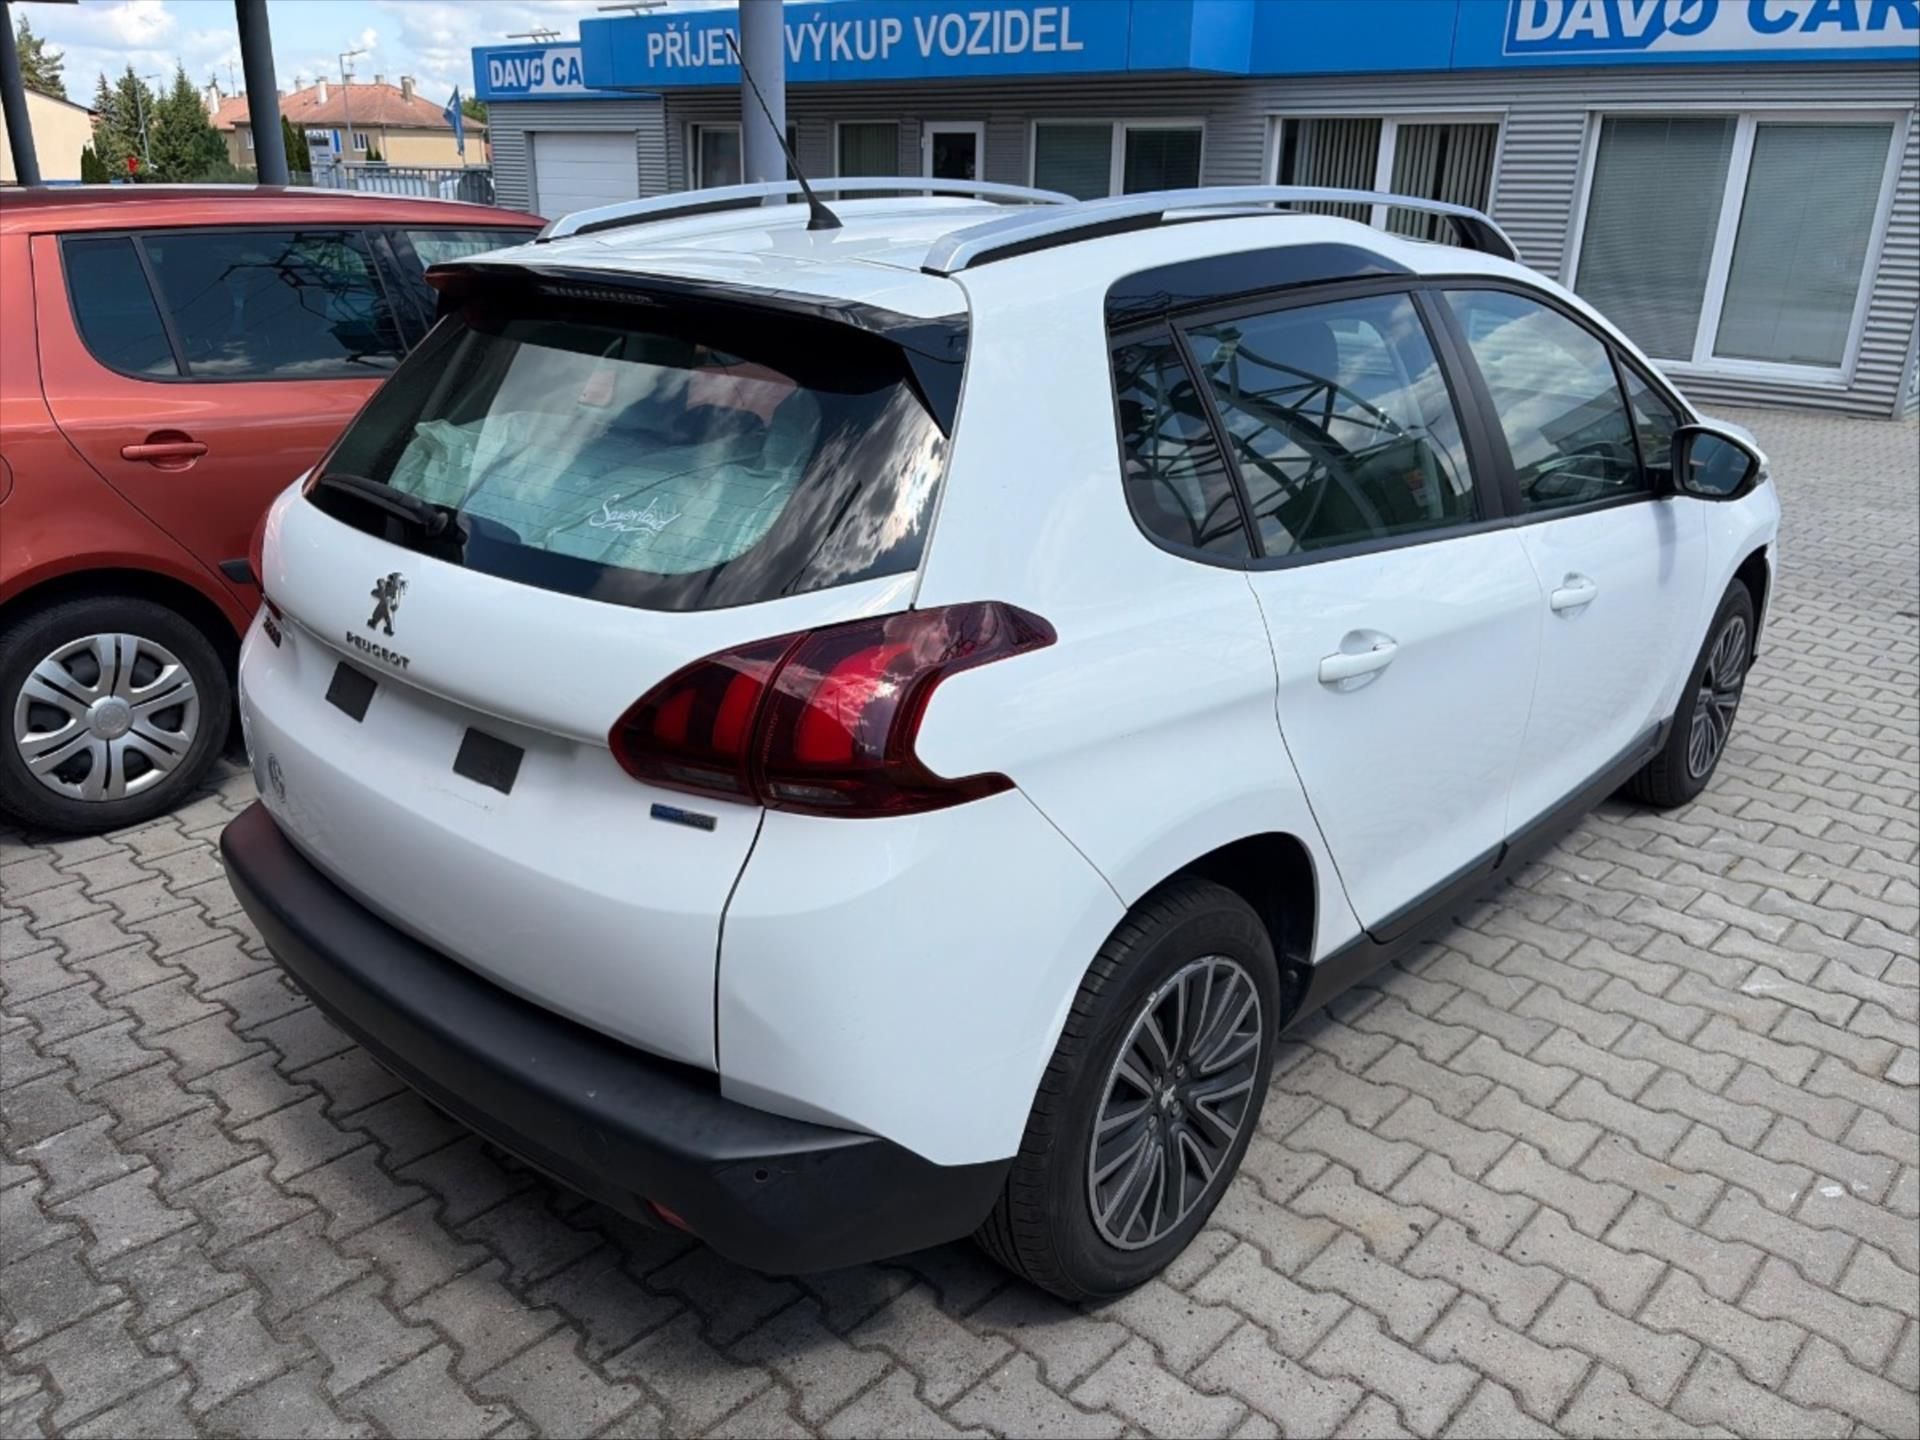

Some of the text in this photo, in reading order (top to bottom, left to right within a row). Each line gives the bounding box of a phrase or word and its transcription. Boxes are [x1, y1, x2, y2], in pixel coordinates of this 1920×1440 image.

[784, 12, 902, 63] VÝKUP
[914, 6, 1083, 57] VOZIDEL
[552, 56, 582, 86] CA
[346, 631, 411, 669] PEUGEOT
